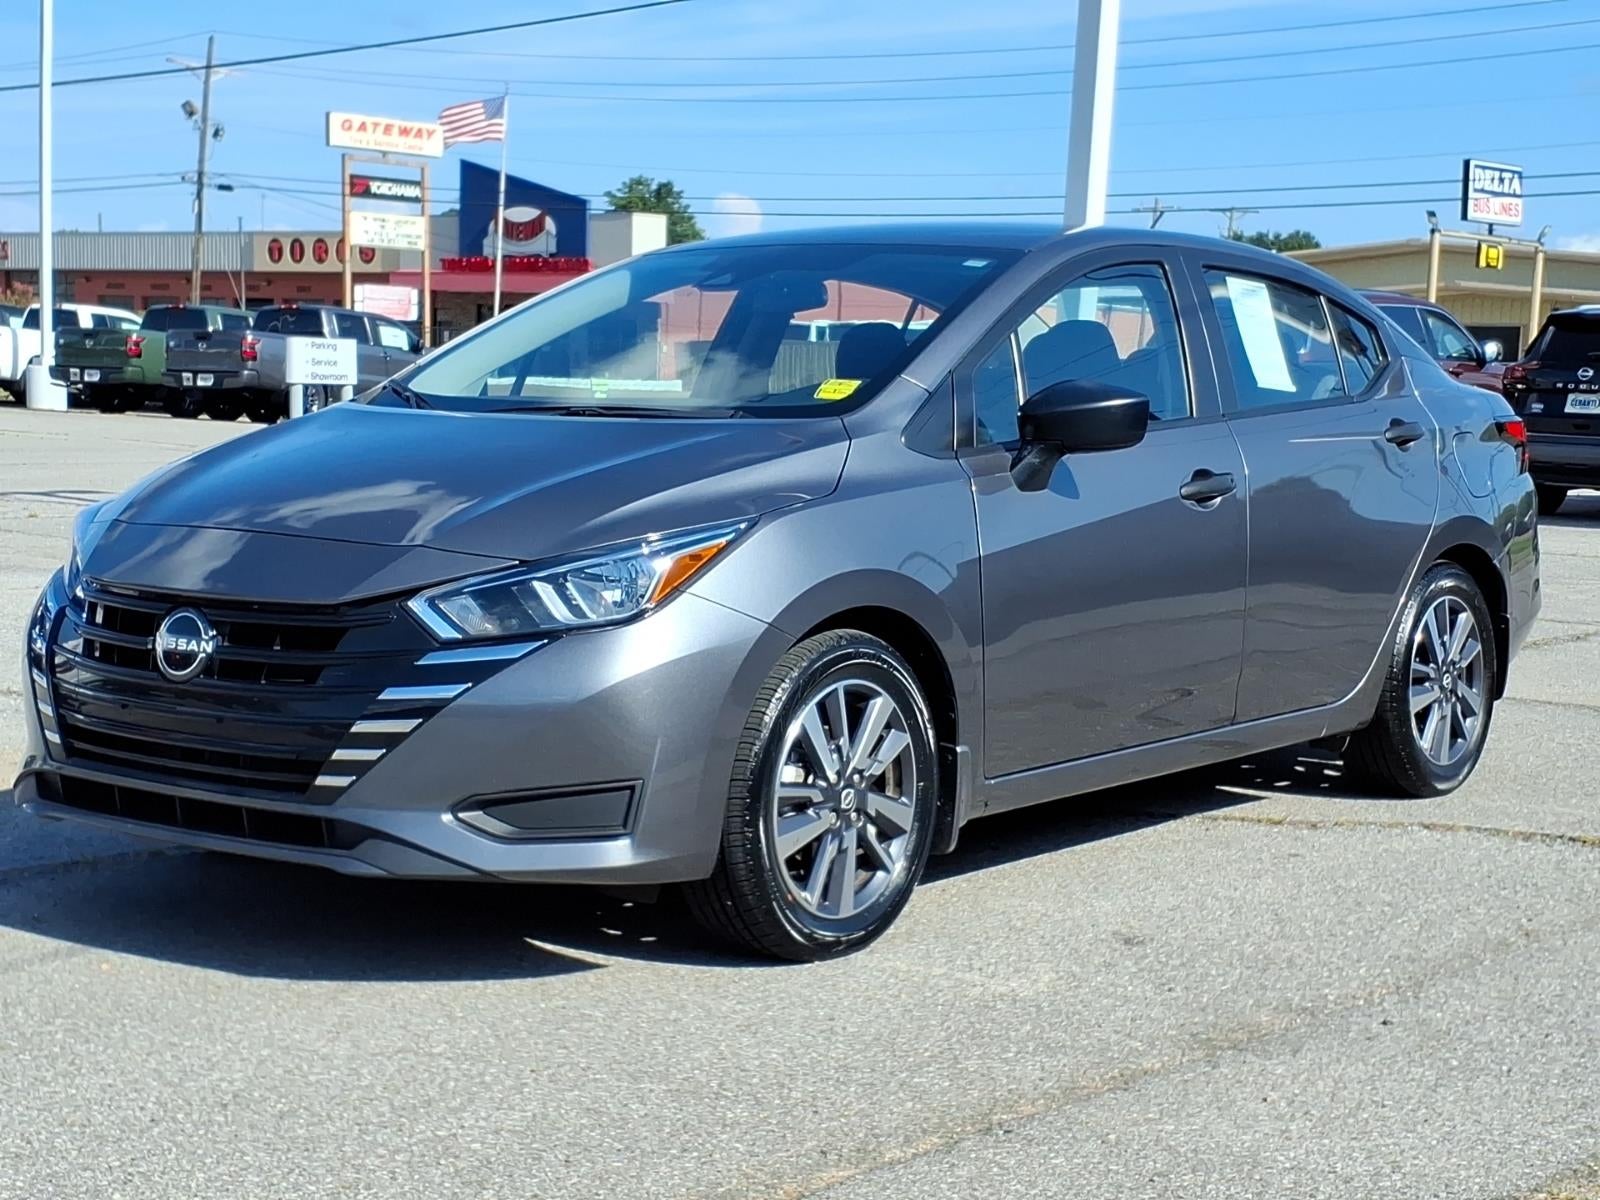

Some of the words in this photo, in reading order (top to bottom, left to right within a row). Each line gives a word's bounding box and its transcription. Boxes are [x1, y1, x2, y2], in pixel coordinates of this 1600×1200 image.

[341, 119, 436, 140] GATEWAY
[369, 181, 422, 198] YOKOHAMA
[1474, 168, 1521, 195] DELTA
[1473, 199, 1491, 214] BUS
[1494, 202, 1520, 217] LINES
[311, 341, 337, 351] Parking
[311, 358, 338, 367] Service
[310, 373, 348, 381] Showroom
